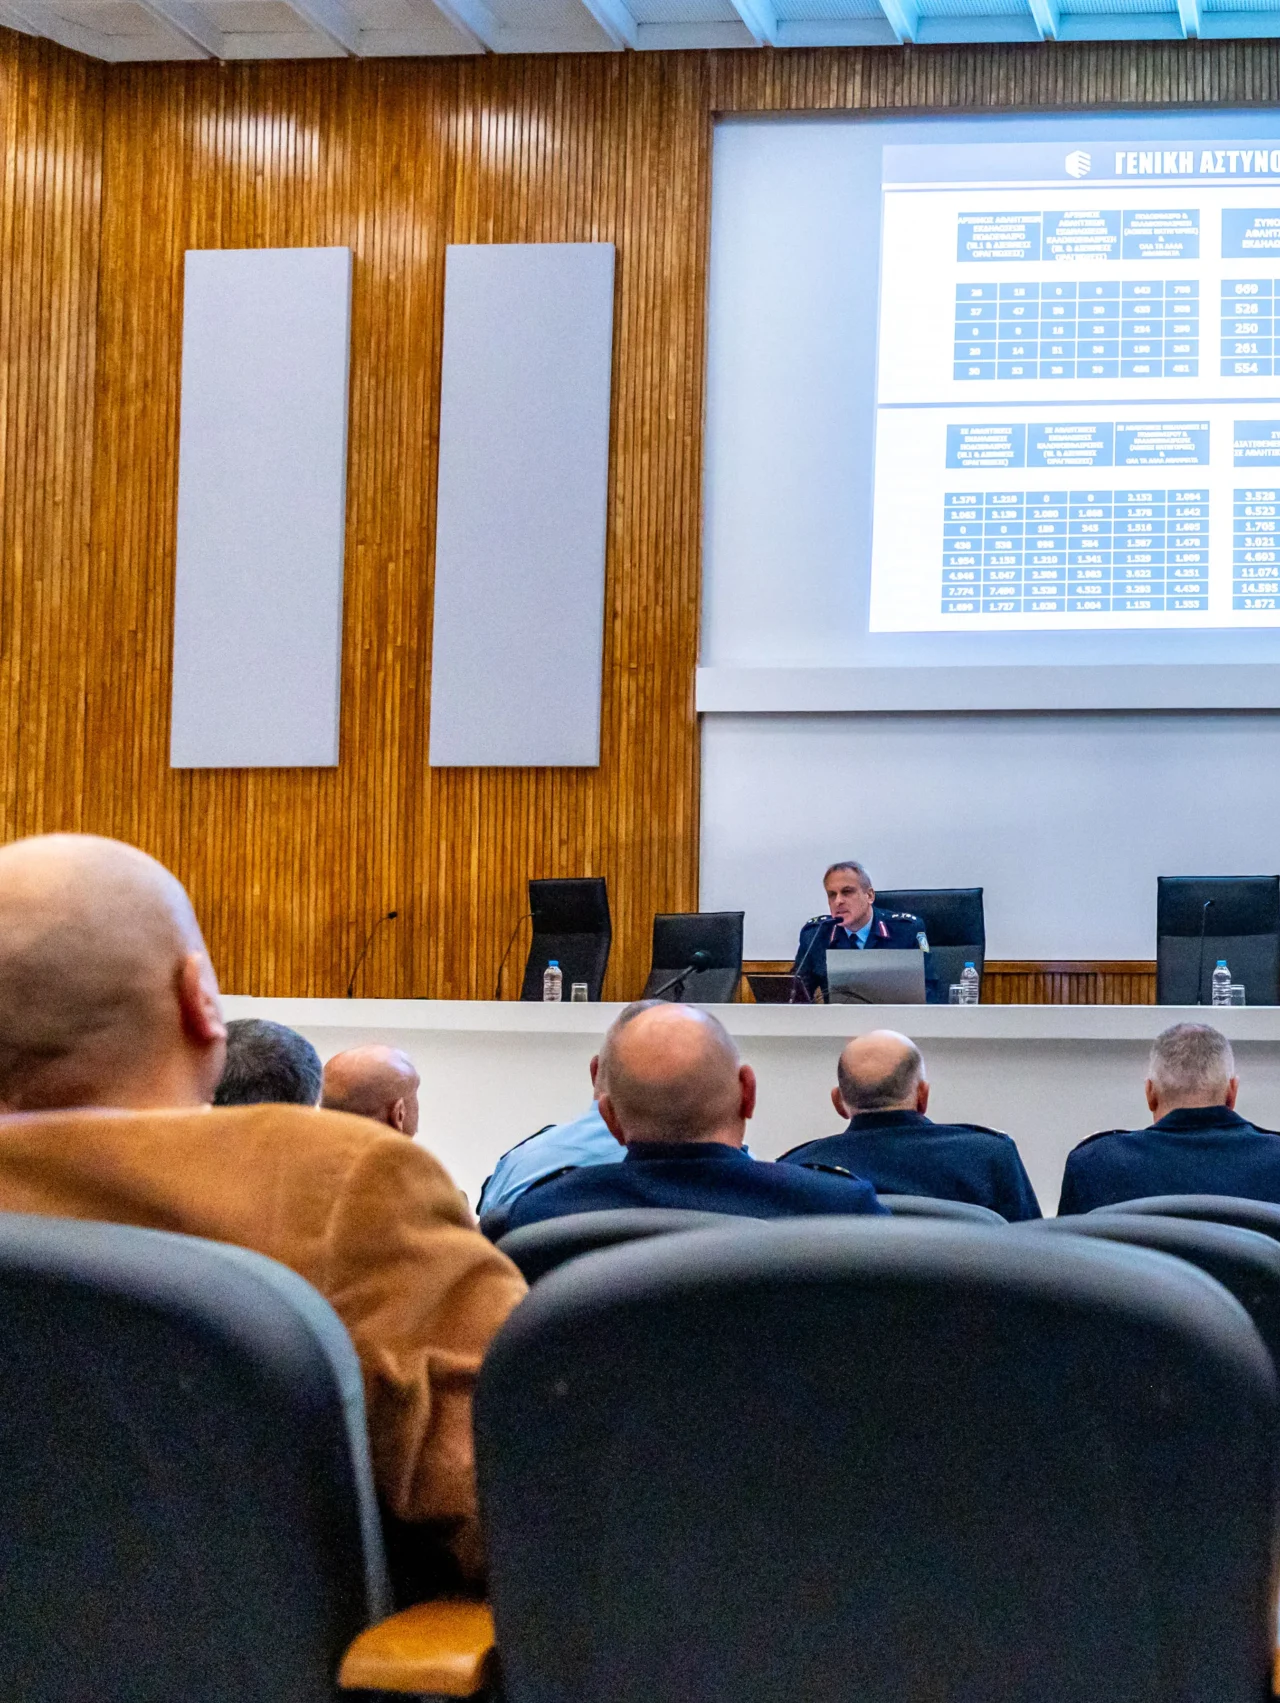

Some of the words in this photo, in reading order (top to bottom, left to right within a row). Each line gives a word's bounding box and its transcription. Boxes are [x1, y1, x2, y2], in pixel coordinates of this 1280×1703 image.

[1115, 151, 1193, 174] ΓΕΝΙΚΗ
[1235, 303, 1258, 314] 526
[1235, 323, 1258, 334] 250
[1235, 363, 1258, 373] 554
[1246, 492, 1275, 500] 3.528
[1245, 507, 1275, 515] 6.523
[1246, 522, 1275, 531] 1.705
[1245, 537, 1276, 548] 3.021
[1242, 568, 1278, 577] 11.074
